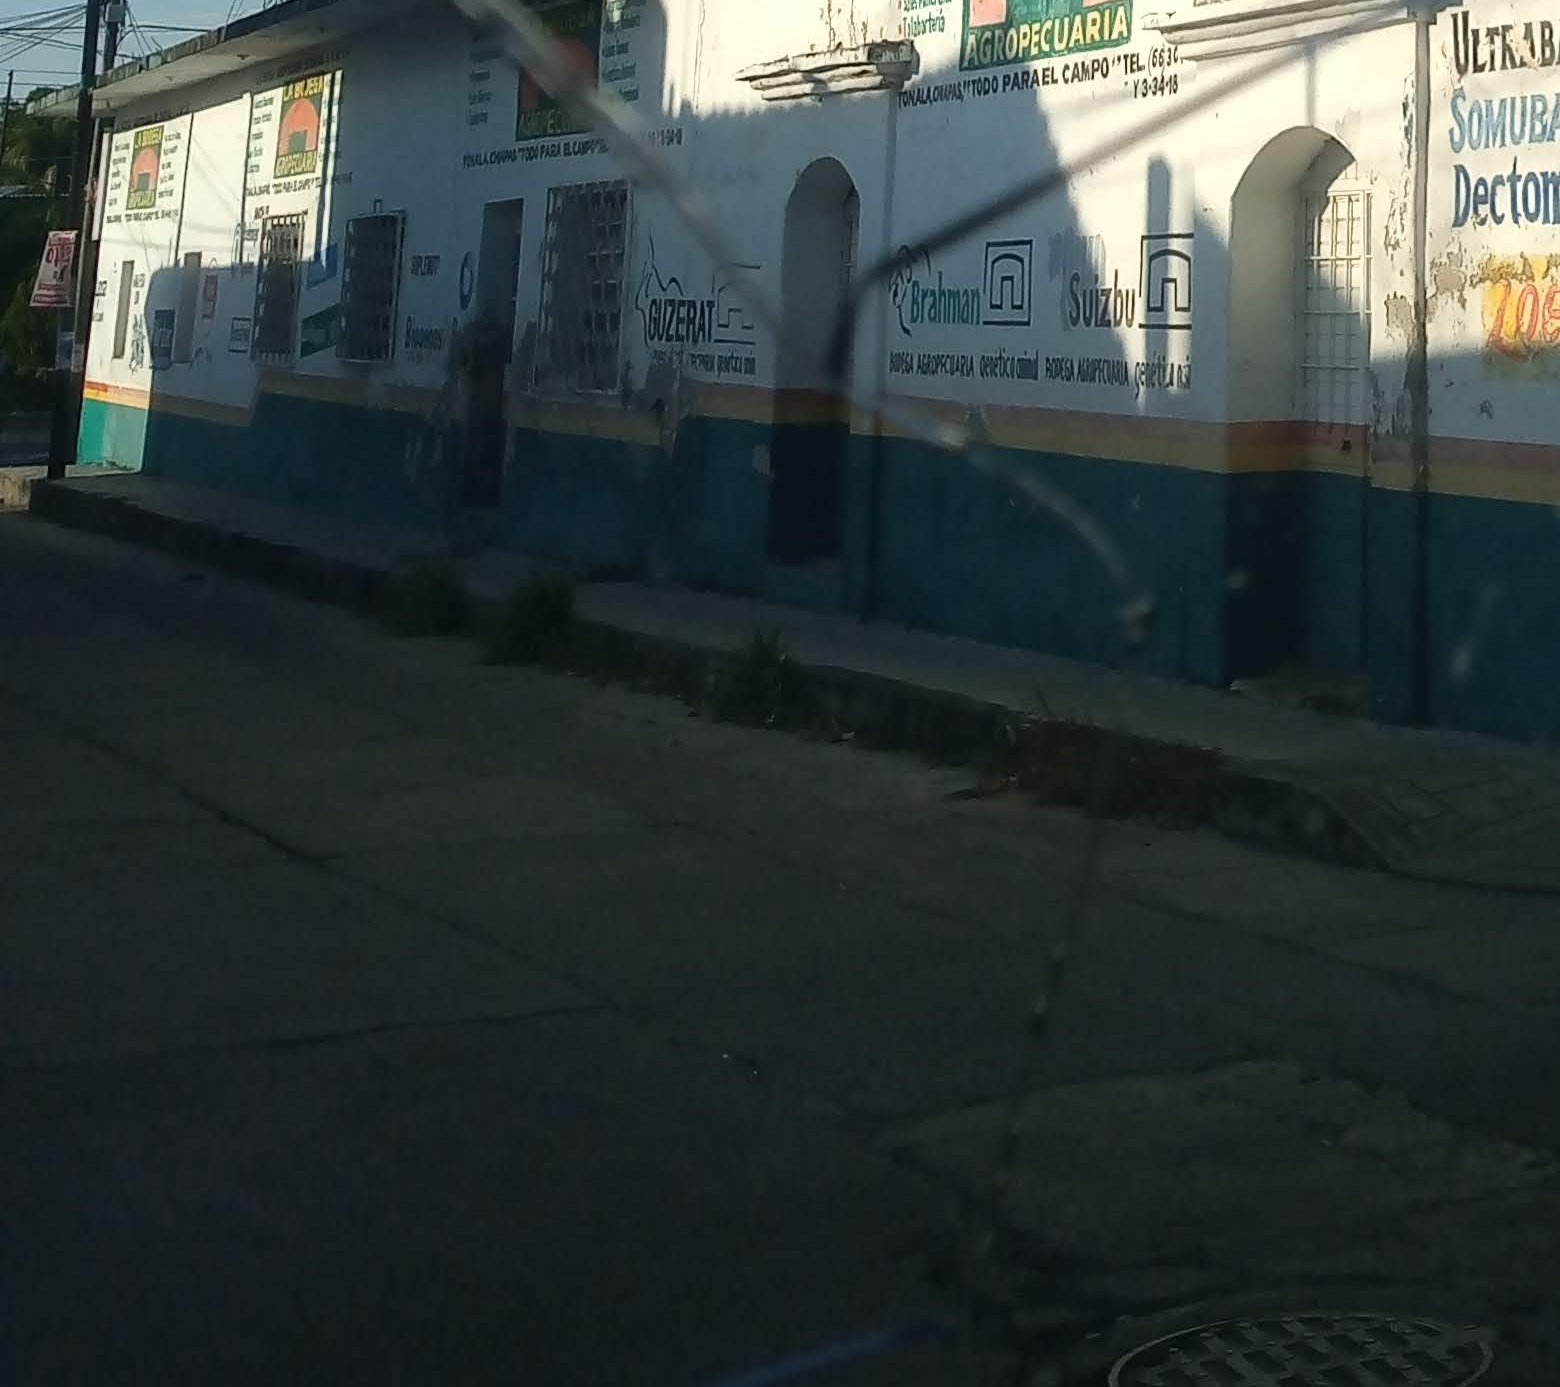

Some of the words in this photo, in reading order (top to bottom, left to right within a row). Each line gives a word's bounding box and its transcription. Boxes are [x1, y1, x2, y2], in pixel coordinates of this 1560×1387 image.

[963, 5, 1128, 67] AGROPECUARIA
[1002, 69, 1039, 93] PARA
[1041, 66, 1058, 86] EL
[649, 298, 716, 343] GUZERAT
[910, 270, 981, 325] Brahman
[1067, 269, 1136, 328] Suizbu
